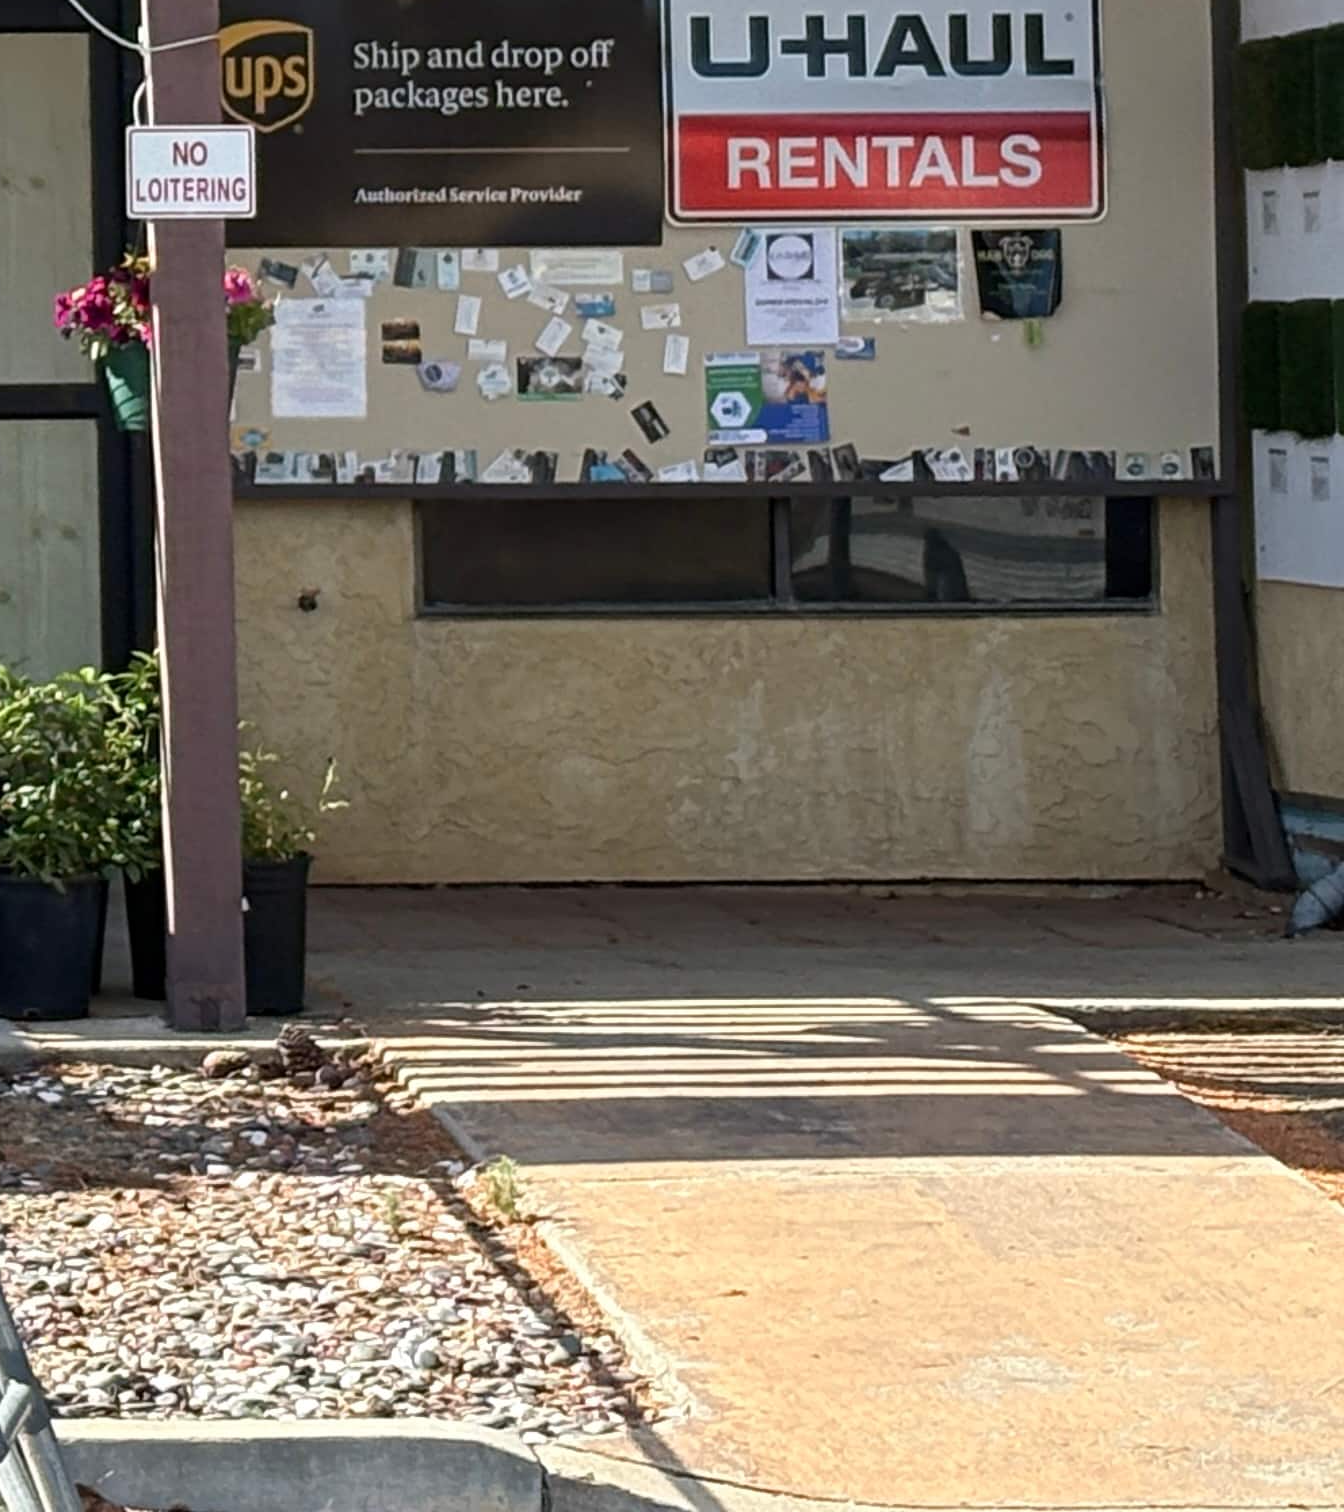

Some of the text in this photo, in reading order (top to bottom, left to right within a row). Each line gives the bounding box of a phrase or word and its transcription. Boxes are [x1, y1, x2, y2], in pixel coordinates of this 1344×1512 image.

[353, 39, 614, 76] Ship and drop off
[689, 13, 1075, 78] U-HAUL
[224, 56, 308, 122] ups
[354, 80, 569, 115] packages here.
[171, 141, 209, 167] NO
[726, 134, 1043, 191] RENTALS
[135, 175, 246, 203] LOITERING
[354, 184, 583, 205] Authorized Service Provider
